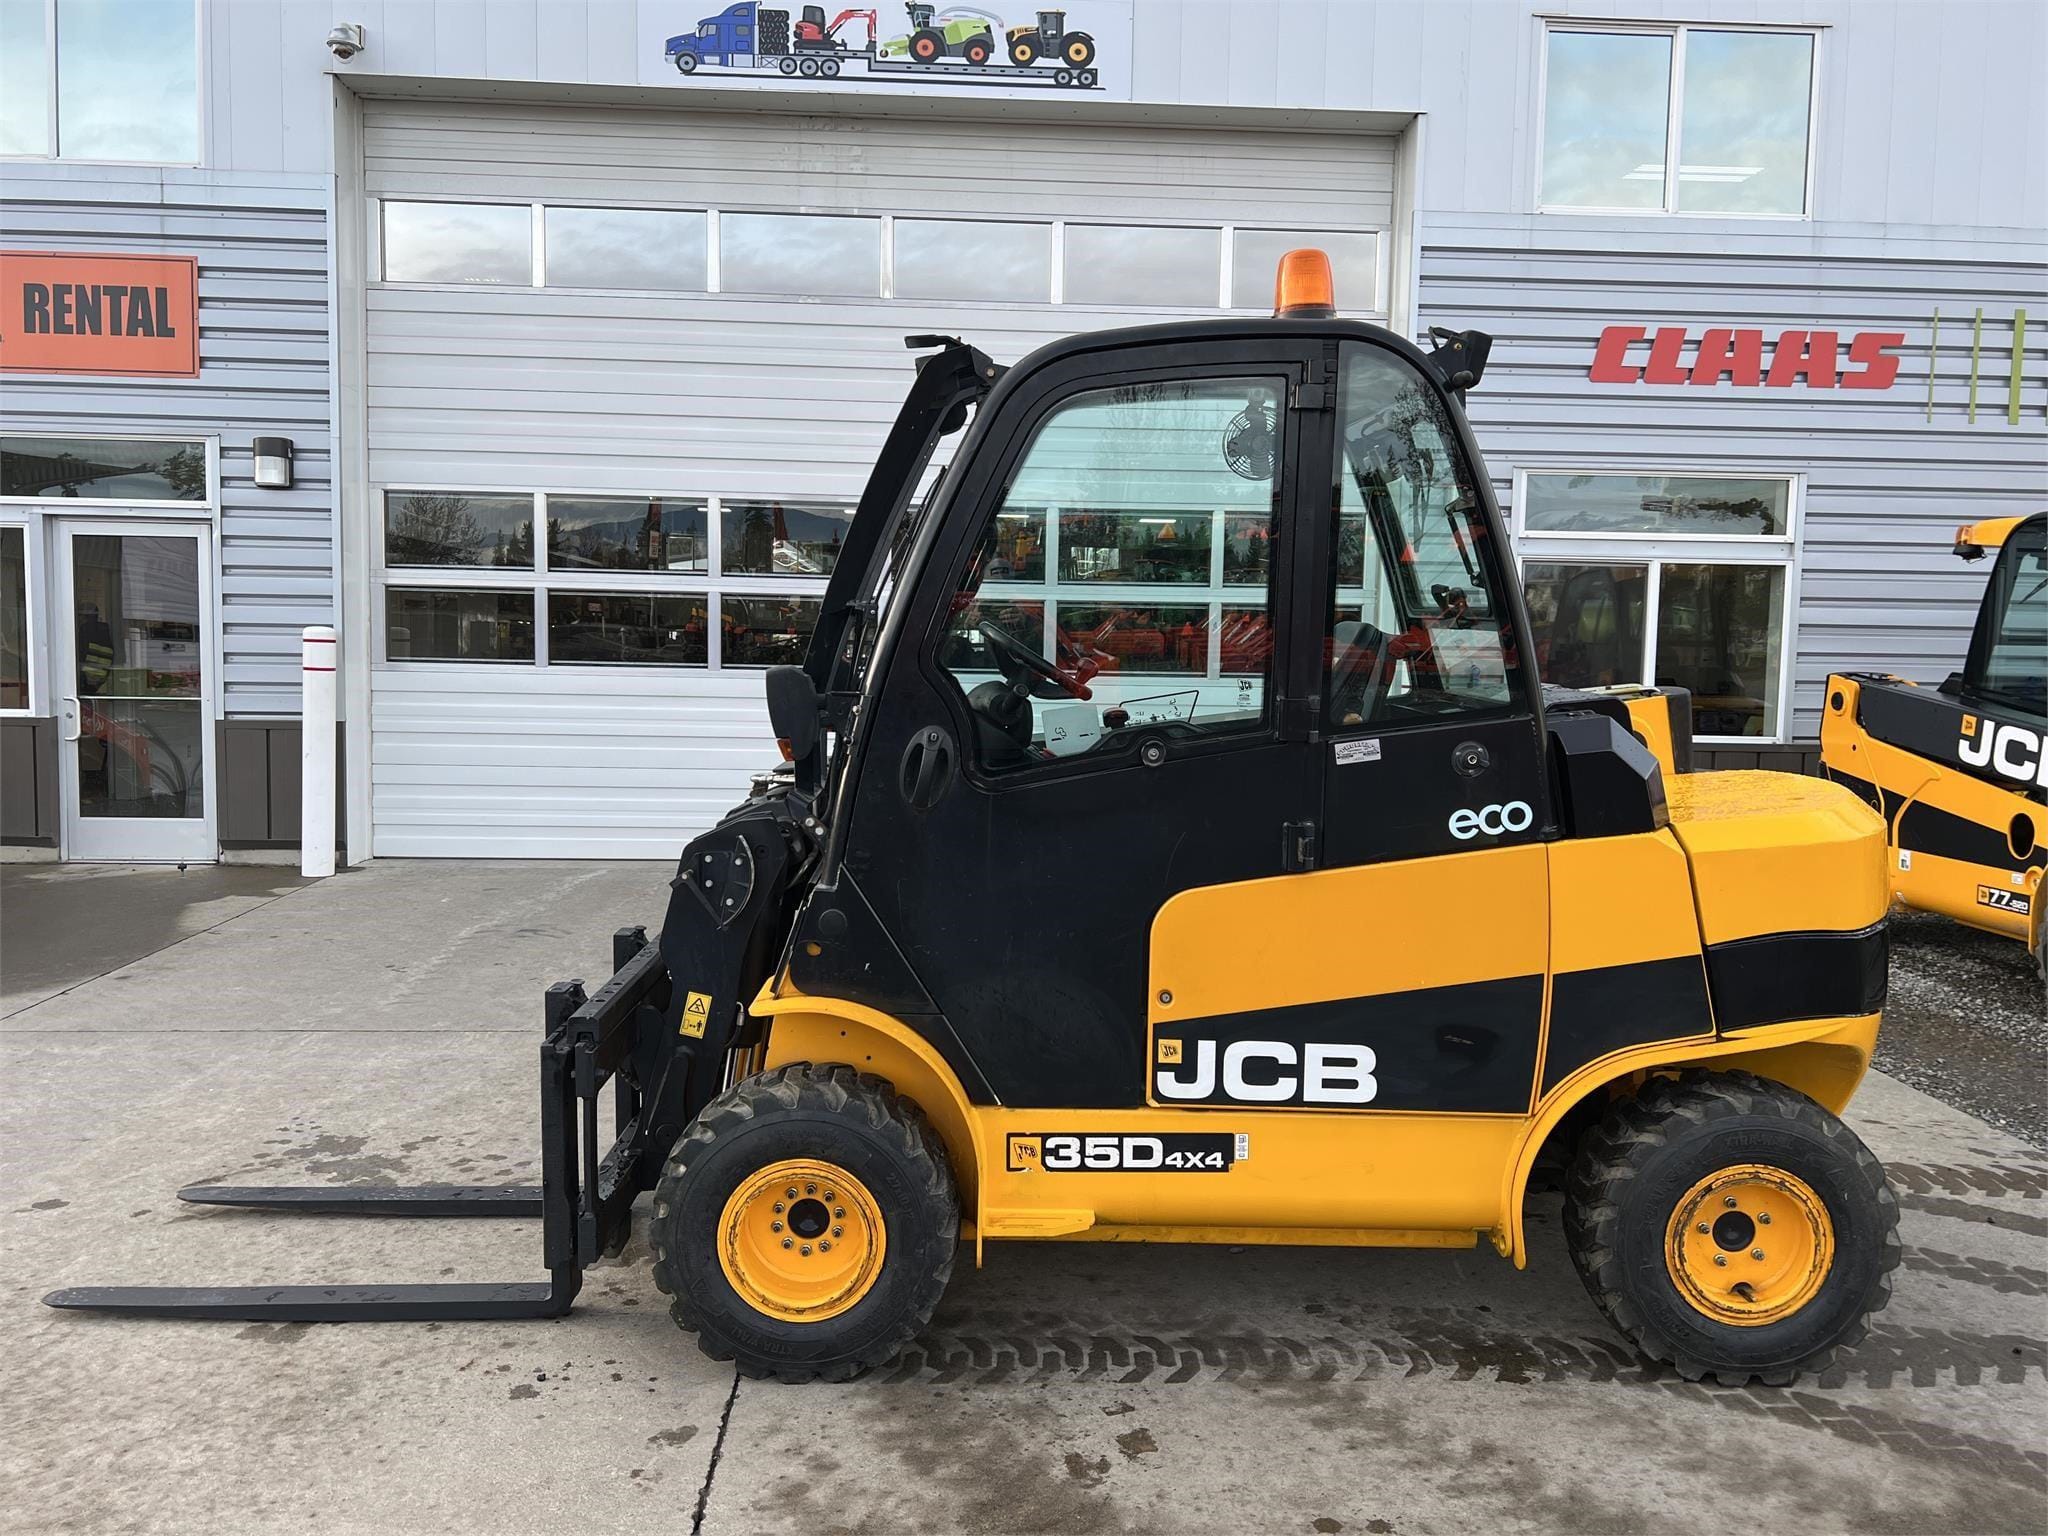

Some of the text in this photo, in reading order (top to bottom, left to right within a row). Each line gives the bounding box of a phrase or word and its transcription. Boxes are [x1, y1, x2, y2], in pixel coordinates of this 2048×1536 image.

[23, 282, 175, 338] RENTAL
[1588, 326, 1905, 389] CLAAS
[1958, 719, 2048, 787] JC
[1448, 800, 1534, 840] eco
[1156, 1039, 1378, 1104] JCB
[1044, 1136, 1165, 1169] 35D
